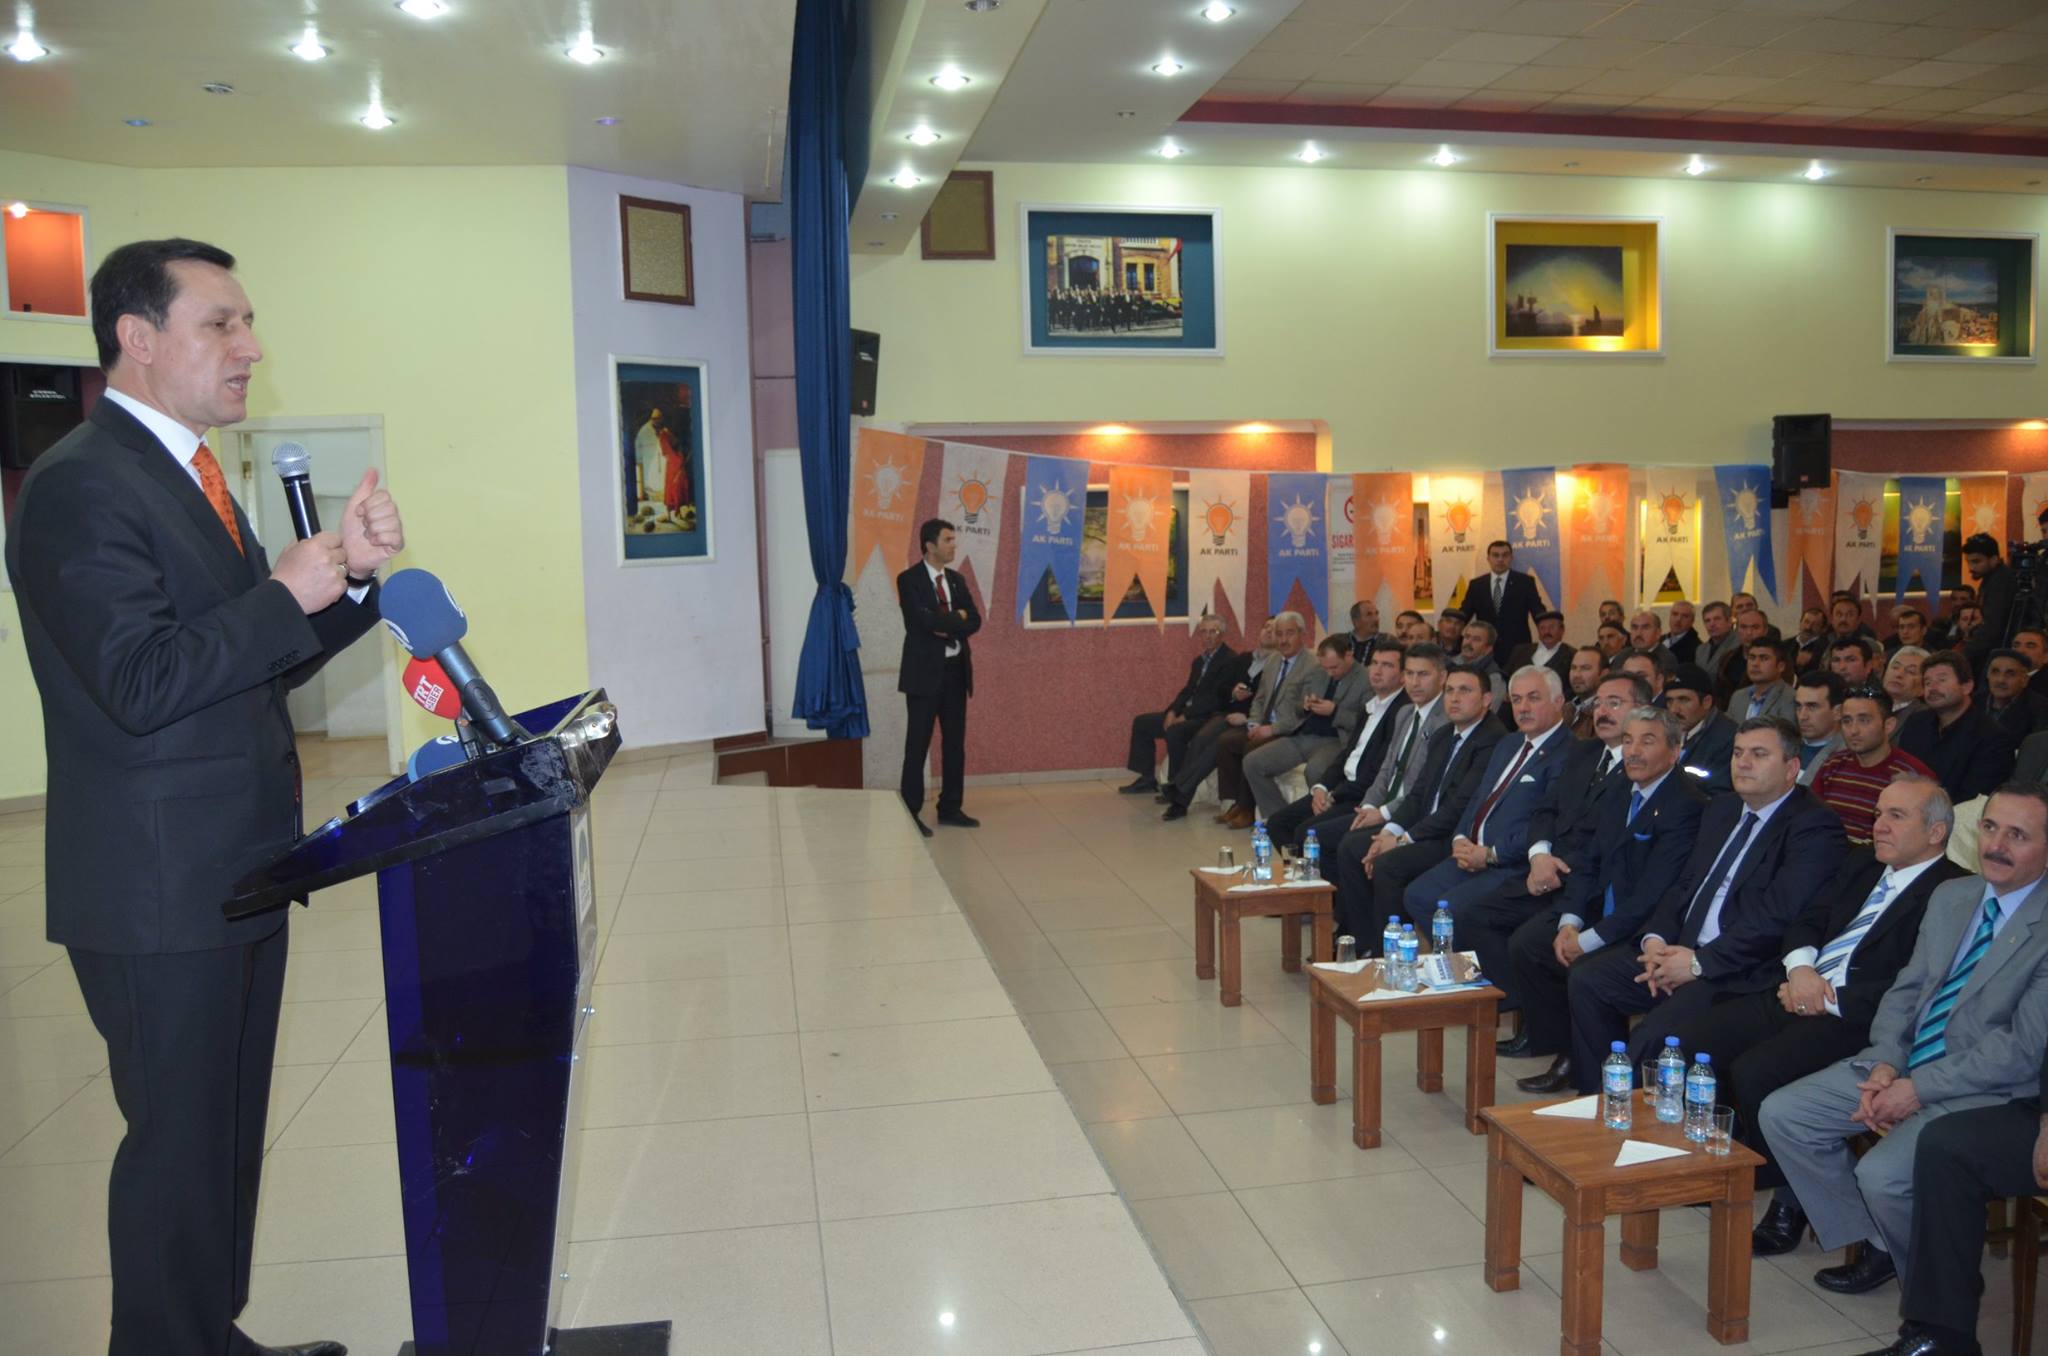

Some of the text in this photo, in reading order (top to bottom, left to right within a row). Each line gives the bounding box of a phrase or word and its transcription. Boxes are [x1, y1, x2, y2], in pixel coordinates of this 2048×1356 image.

[1032, 534, 1046, 543] AK
[1200, 548, 1212, 556] AK
[1279, 549, 1292, 557] AK
[1441, 545, 1454, 553] AK
[413, 674, 433, 706] TRT
